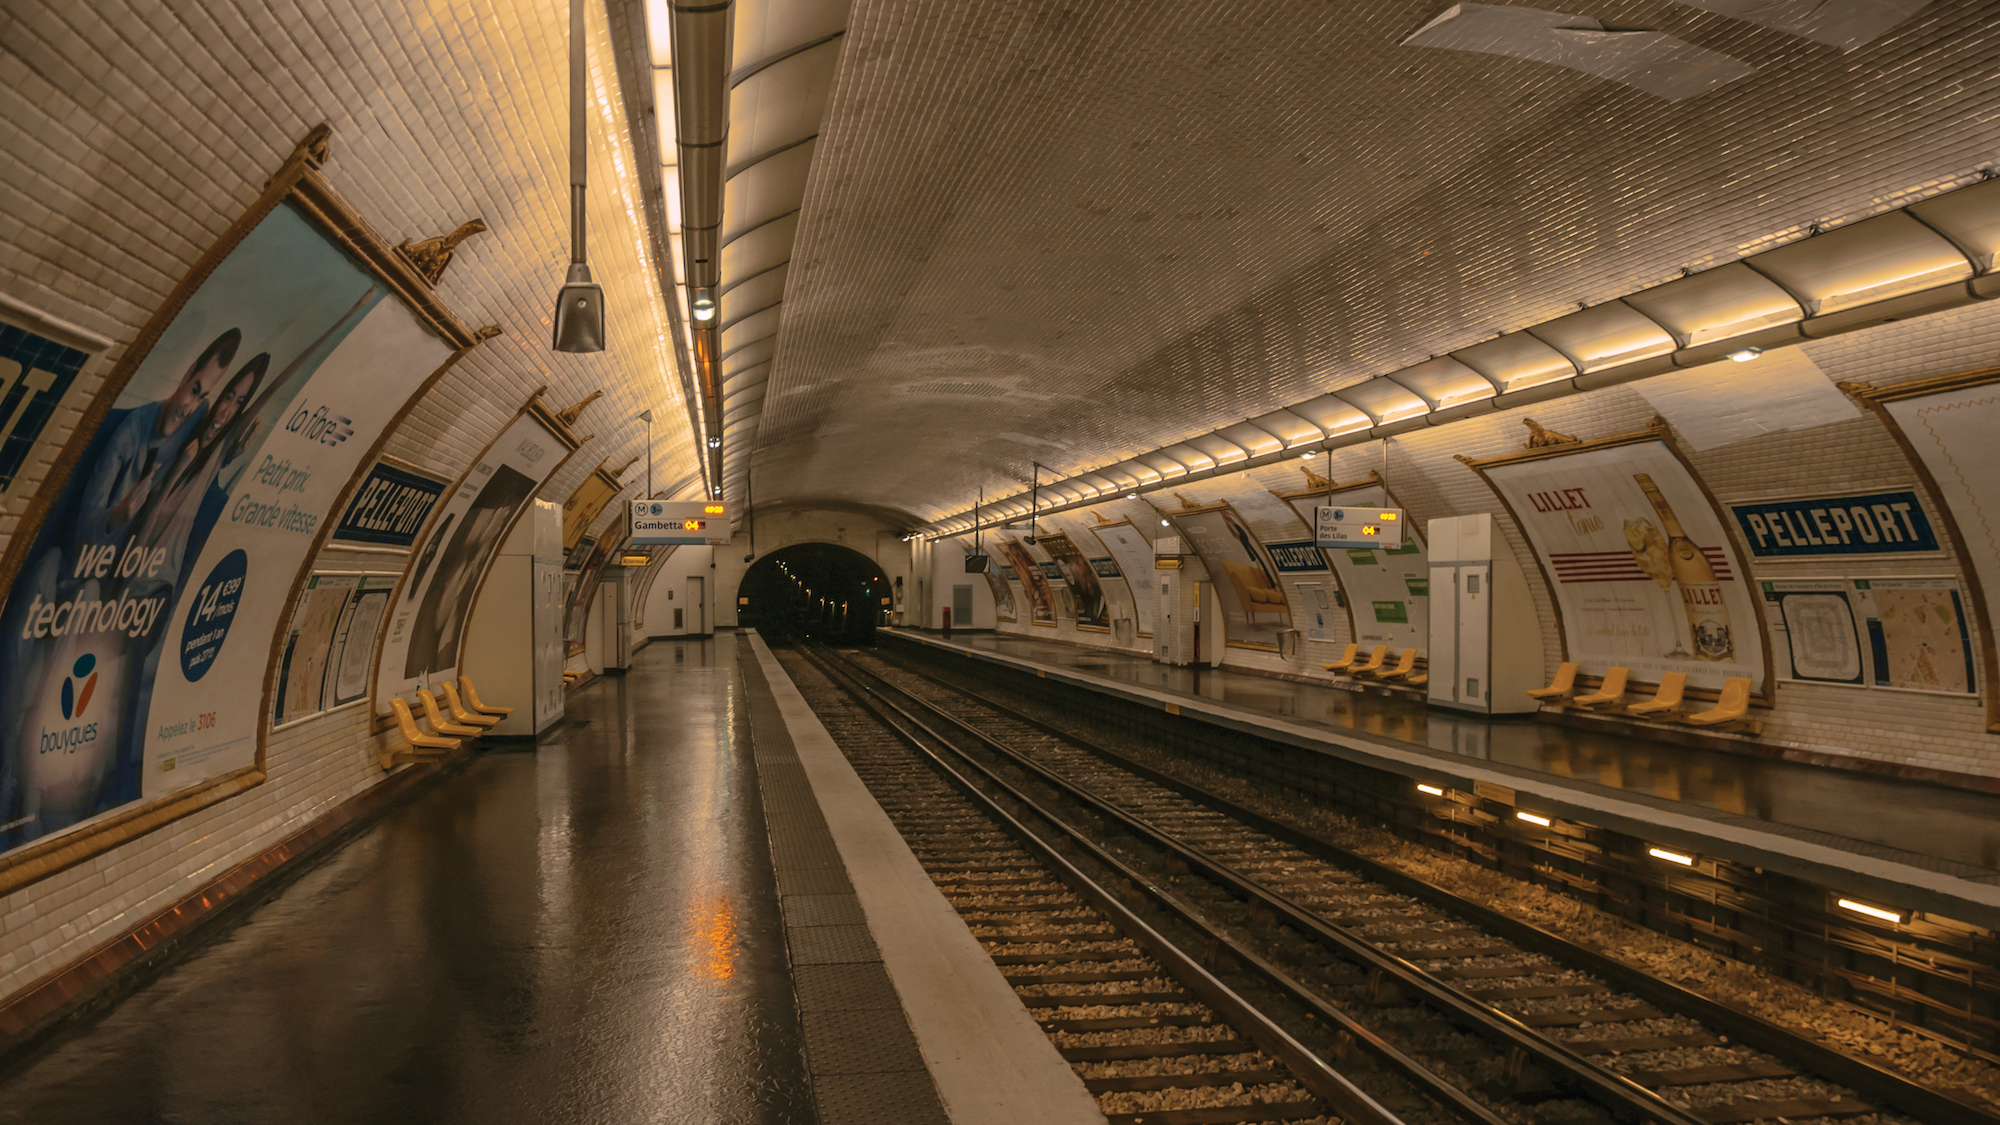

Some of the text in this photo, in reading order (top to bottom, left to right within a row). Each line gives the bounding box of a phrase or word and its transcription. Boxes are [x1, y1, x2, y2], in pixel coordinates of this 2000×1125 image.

[300, 405, 337, 443] fibre
[252, 454, 291, 488] Petit
[231, 493, 280, 528] Grande
[346, 476, 437, 535] PELLEPORT
[1527, 488, 1591, 513] LILLET
[634, 521, 683, 530] Gambetta
[685, 520, 699, 531] 04
[1362, 525, 1375, 536] 04
[1746, 502, 1919, 548] PELLEPORT
[73, 534, 167, 579] we love
[1270, 546, 1323, 567] PELLEPORT
[192, 581, 224, 627] 14
[1680, 588, 1723, 605] LILLET
[22, 588, 166, 640] technology
[184, 630, 213, 655] pendant
[215, 628, 225, 640] an
[40, 722, 98, 755] bouygues
[157, 711, 216, 742] Appelez le 3106
